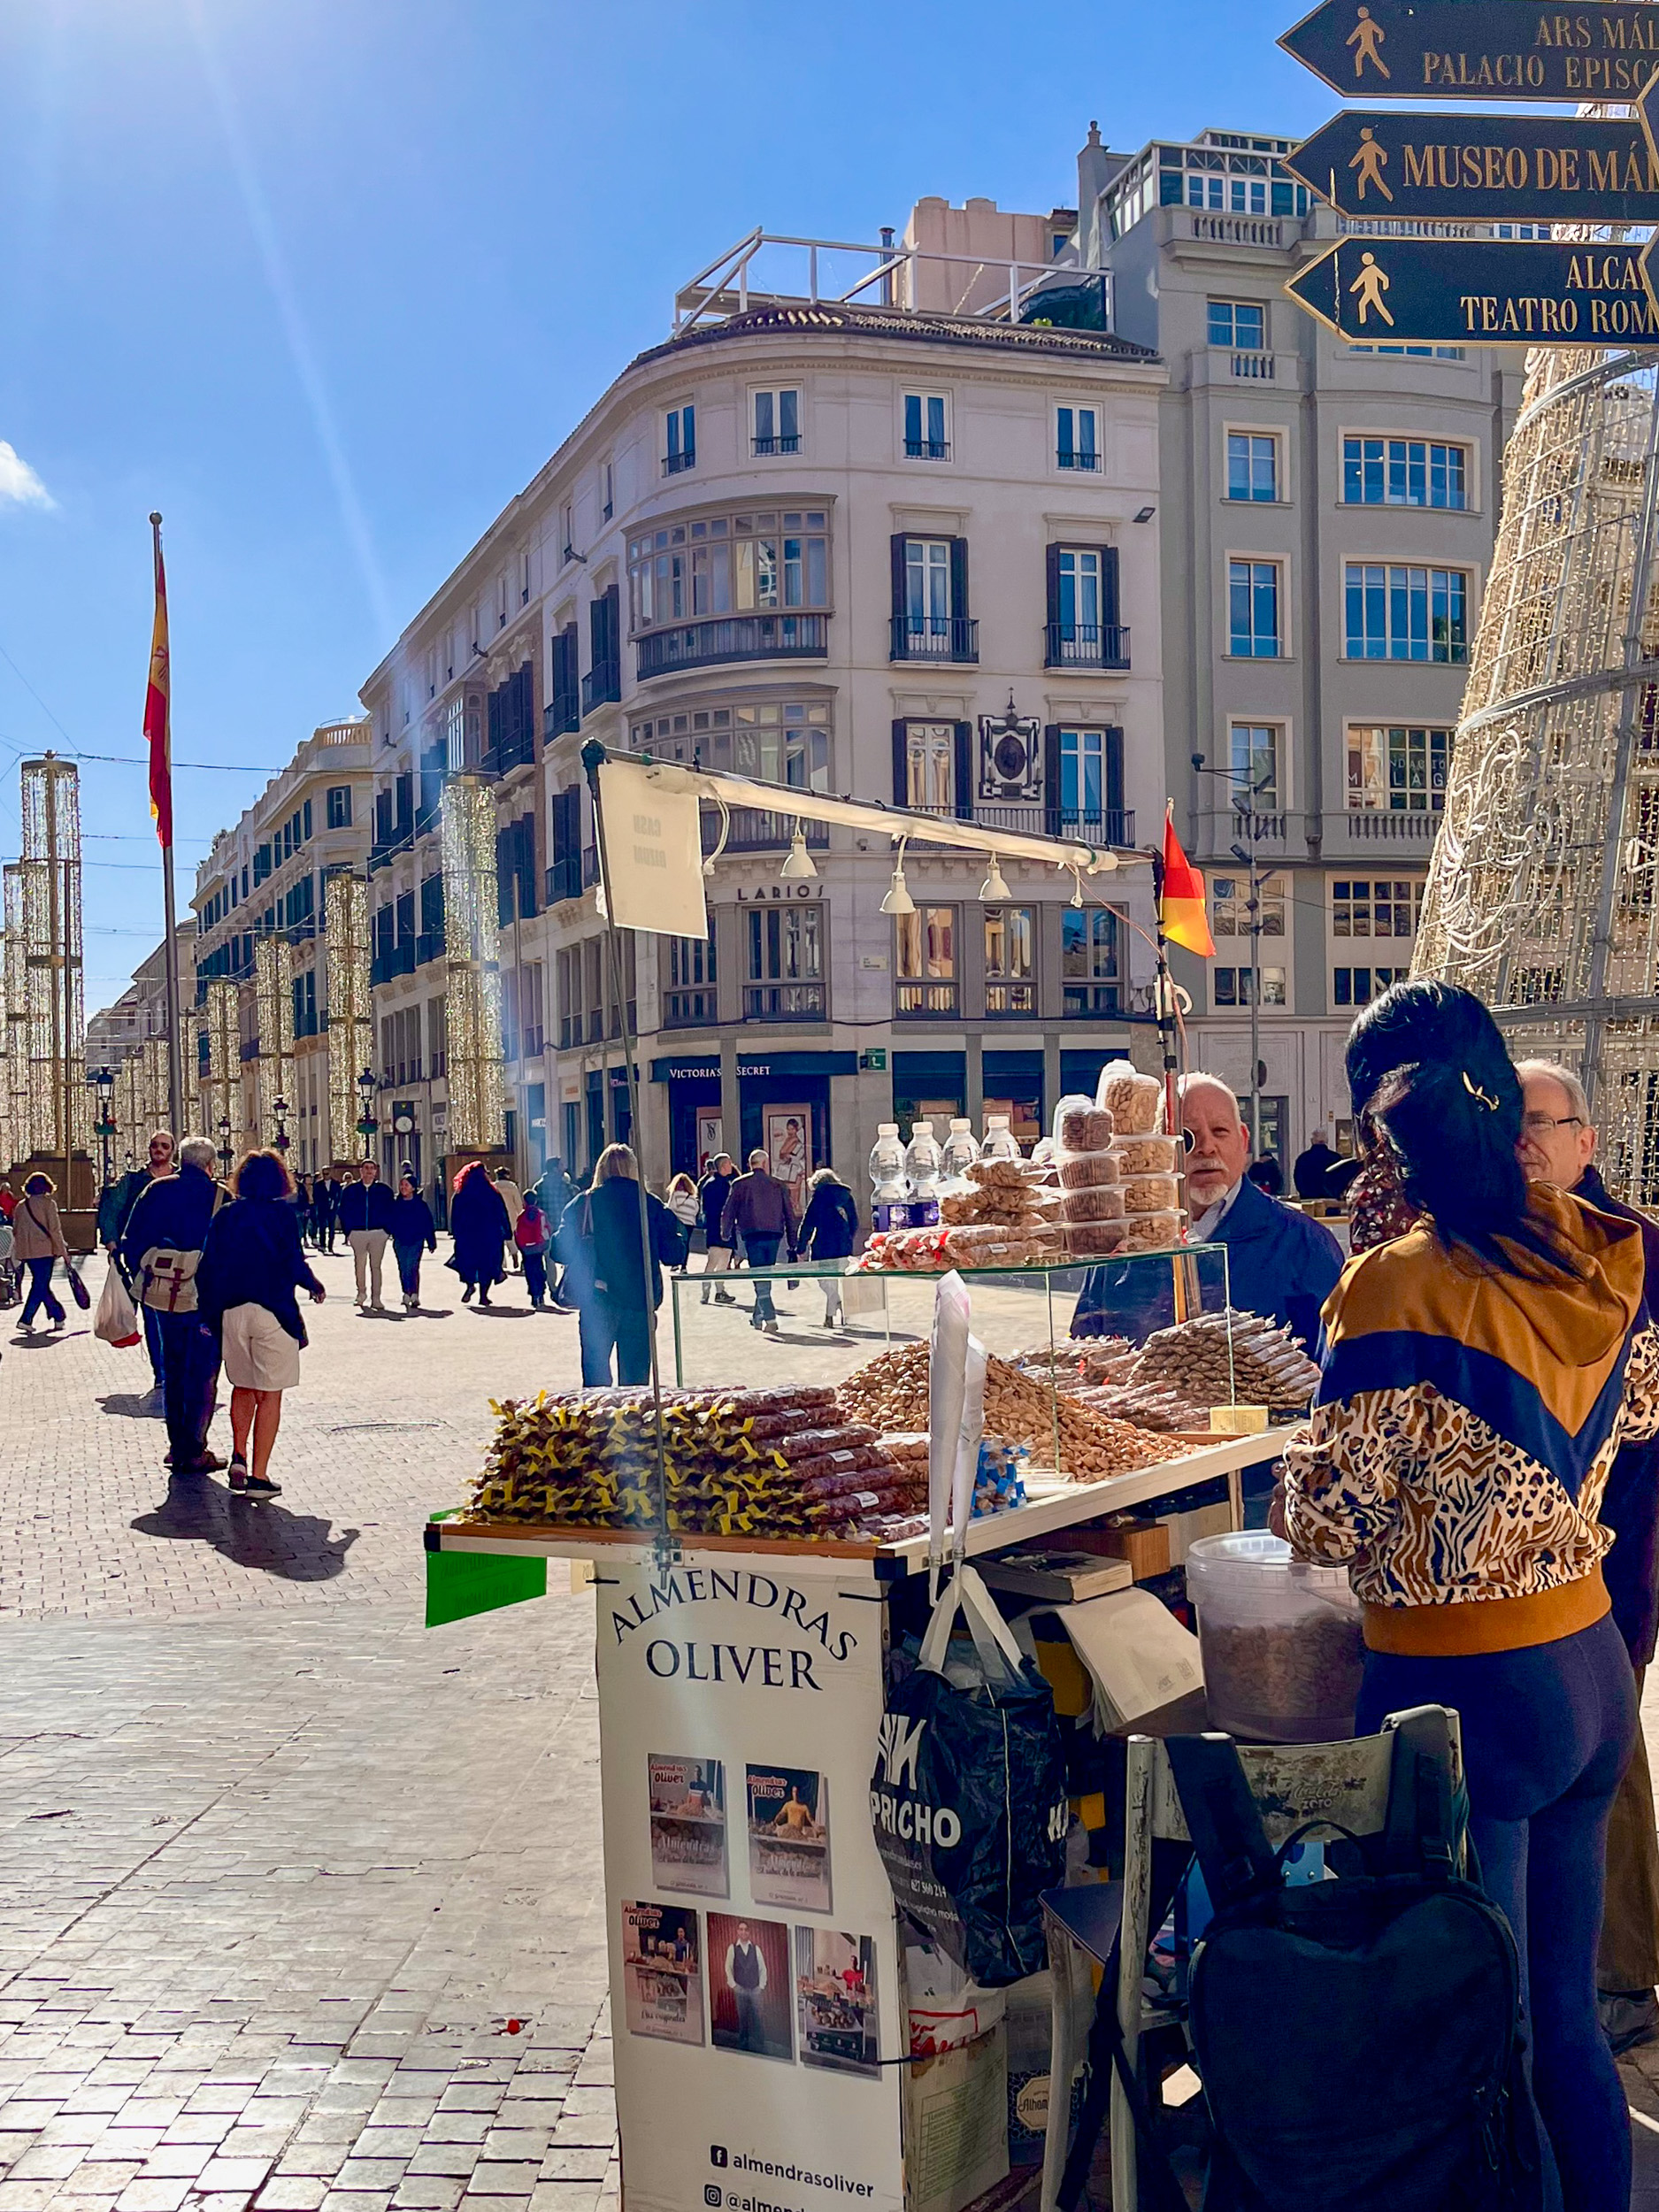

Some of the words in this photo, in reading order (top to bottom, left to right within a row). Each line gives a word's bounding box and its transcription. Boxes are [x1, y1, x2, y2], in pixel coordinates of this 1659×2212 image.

[1534, 15, 1592, 48] ARS
[1423, 51, 1545, 88] PALACIO
[1402, 144, 1528, 190] MUSEO
[1534, 148, 1580, 191] DE
[1564, 254, 1646, 290] ALCA
[1460, 296, 1578, 333] TEATRO
[737, 885, 824, 901] LARIOS
[669, 1067, 722, 1079] VICTORIA'S
[736, 1065, 771, 1076] SECRET
[611, 1568, 858, 1662] ALMENDRAS
[645, 1639, 824, 1691] OLIVER
[870, 1790, 962, 1847] PRICHO
[1302, 1798, 1333, 1809] zero
[733, 2153, 874, 2198] almendrasoliver
[726, 2192, 804, 2212] @alme
